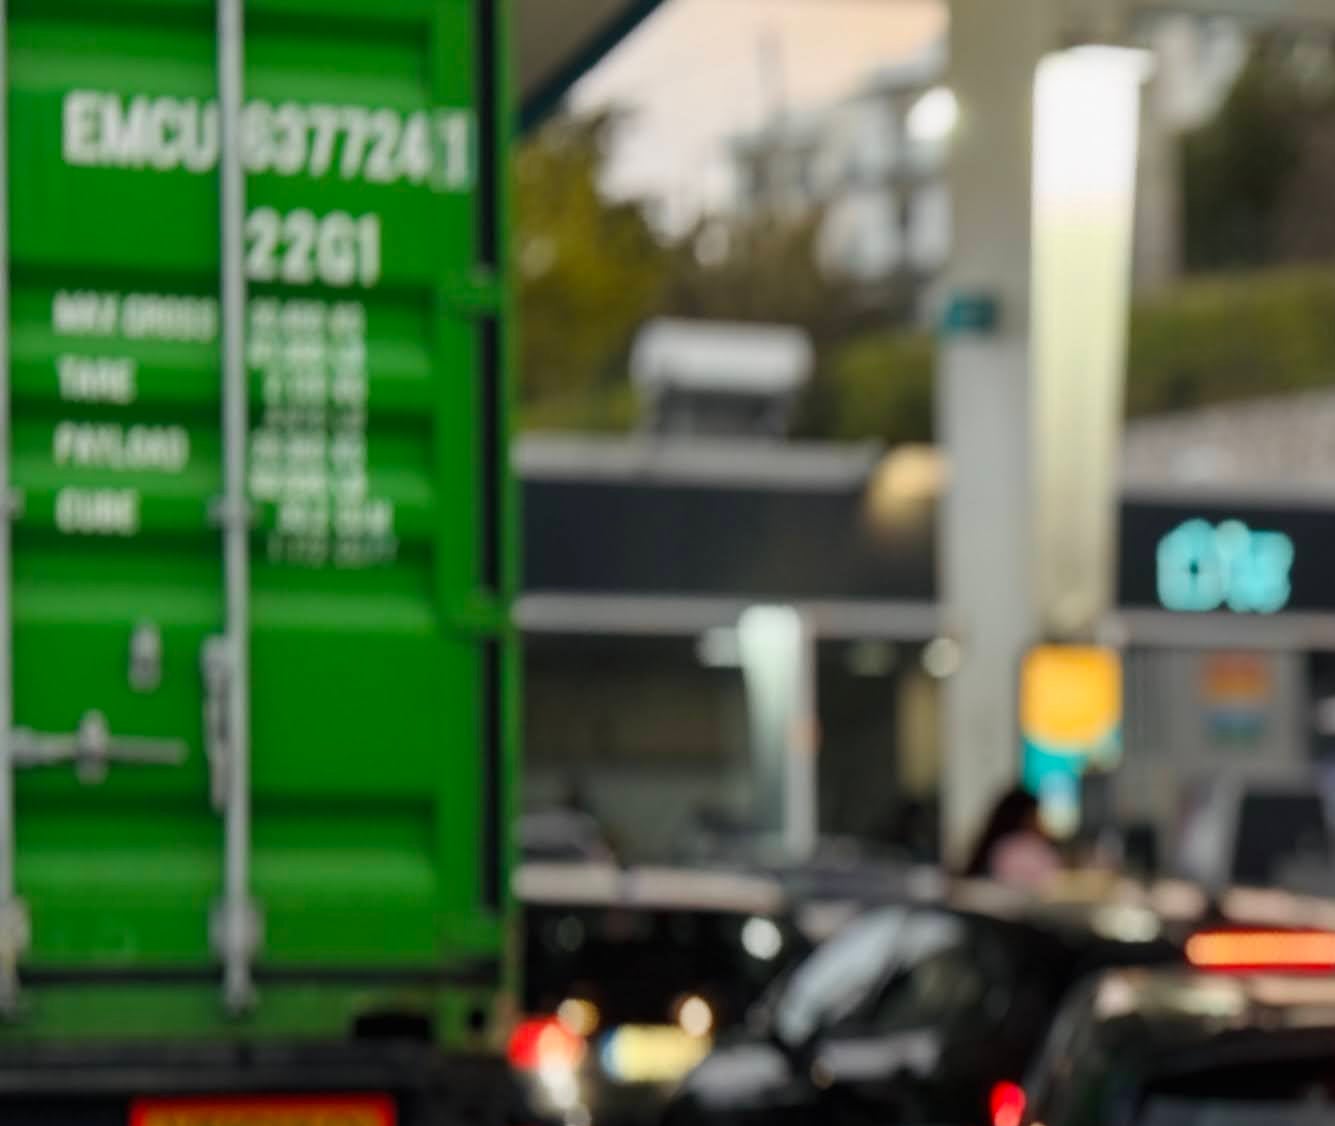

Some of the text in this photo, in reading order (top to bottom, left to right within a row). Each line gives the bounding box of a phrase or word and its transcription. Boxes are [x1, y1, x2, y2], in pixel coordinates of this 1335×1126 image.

[63, 91, 220, 171] EMCU
[239, 101, 432, 183] 637724
[245, 208, 381, 287] 22G1
